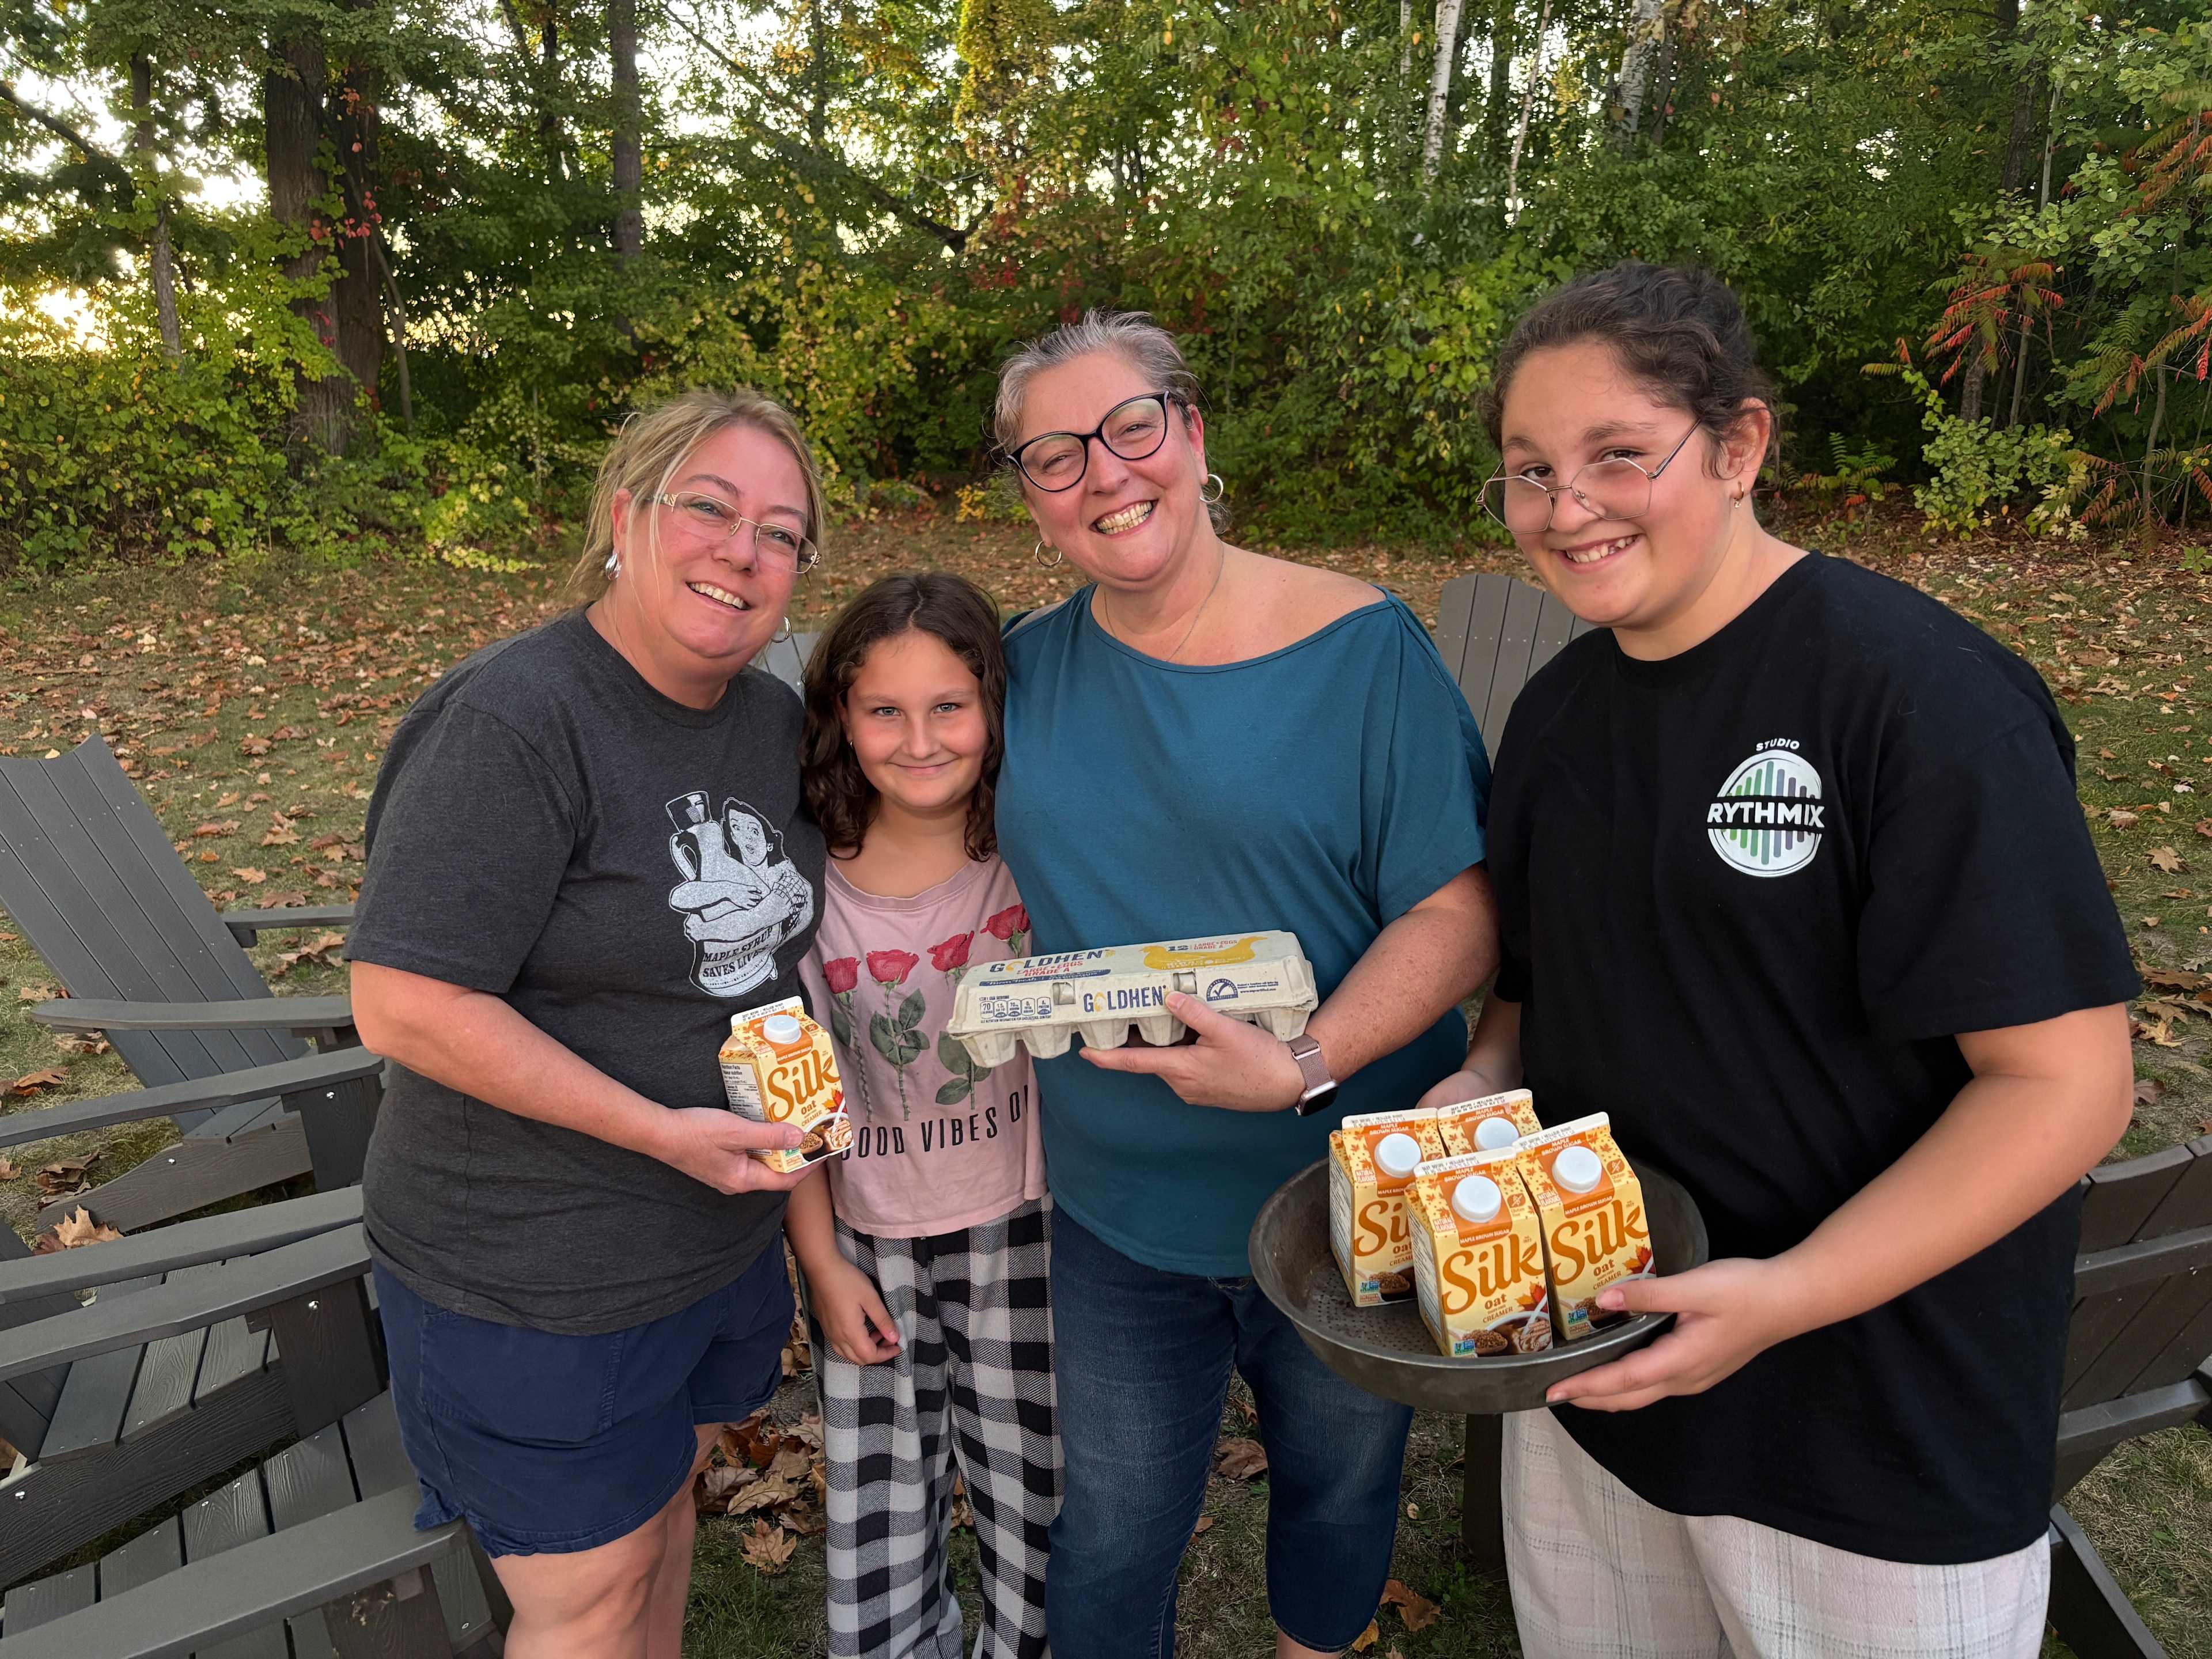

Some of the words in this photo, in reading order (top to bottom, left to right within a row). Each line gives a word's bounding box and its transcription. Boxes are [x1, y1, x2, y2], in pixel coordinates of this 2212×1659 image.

[1756, 738, 1800, 751] STUDIO
[1707, 802, 1825, 828] RYTHMIX
[703, 948, 739, 962] MAPLE
[739, 925, 773, 955] SYRUP
[703, 962, 736, 977] SAVES
[1017, 966, 1049, 974] LARGE
[1055, 961, 1084, 969] EGGS
[767, 1050, 840, 1122] Silk
[801, 1100, 817, 1115] oat
[802, 1110, 823, 1126] CREAMER
[1465, 1114, 1486, 1122] BROWN
[841, 1127, 904, 1161] OOD
[922, 1107, 998, 1152] VIBES
[1552, 1138, 1569, 1147] MAPLE
[1541, 1146, 1563, 1156] BROWN
[1563, 1139, 1582, 1148] SUGAR
[1444, 1174, 1466, 1182] BROWN
[1565, 1206, 1580, 1215] MAPLE
[1580, 1201, 1597, 1211] BROWN
[1597, 1195, 1613, 1205] SUGAR
[1354, 1200, 1411, 1257] Si
[1475, 1232, 1494, 1241] BROWN
[1494, 1229, 1510, 1237] SUGAR
[1551, 1199, 1649, 1286] Silk
[1389, 1255, 1413, 1266] CREAM
[1594, 1259, 1615, 1277] oat
[1442, 1234, 1544, 1315] Silk
[1593, 1271, 1622, 1290] CREAMER
[1484, 1293, 1507, 1309] oat
[1483, 1306, 1513, 1323] CREAMER
